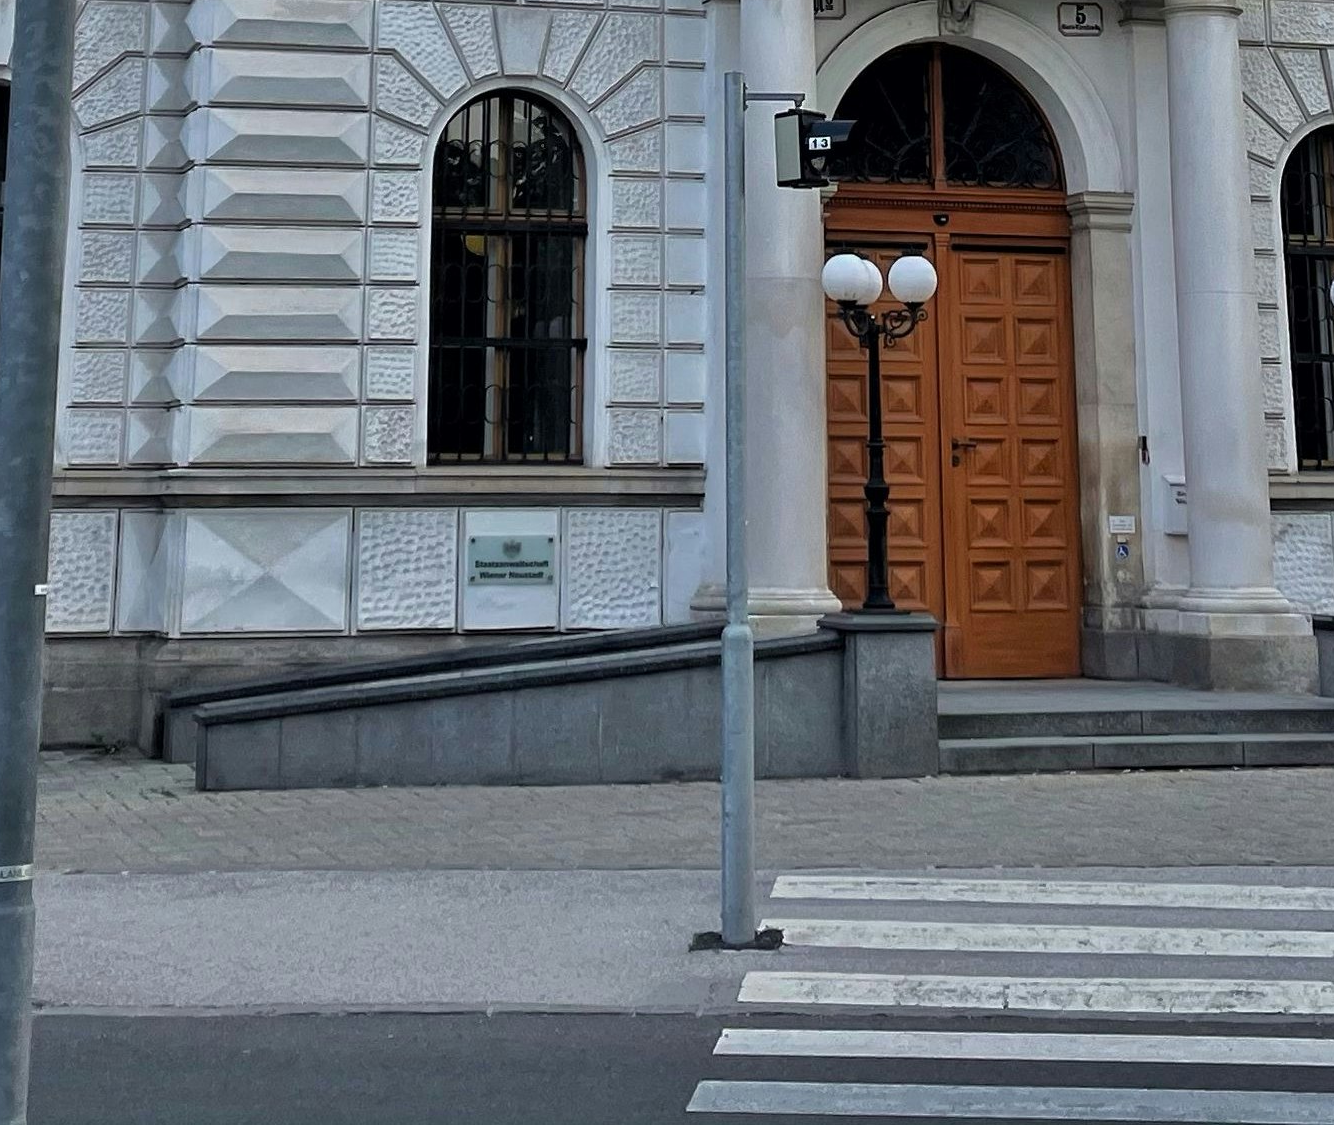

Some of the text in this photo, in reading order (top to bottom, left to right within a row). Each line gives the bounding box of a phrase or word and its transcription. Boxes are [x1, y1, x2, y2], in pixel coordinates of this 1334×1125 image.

[1075, 4, 1087, 25] 5
[812, 138, 828, 149] 13
[474, 560, 549, 568] Staatsanwaltschaft
[479, 571, 544, 579] Wiener Neustadt
